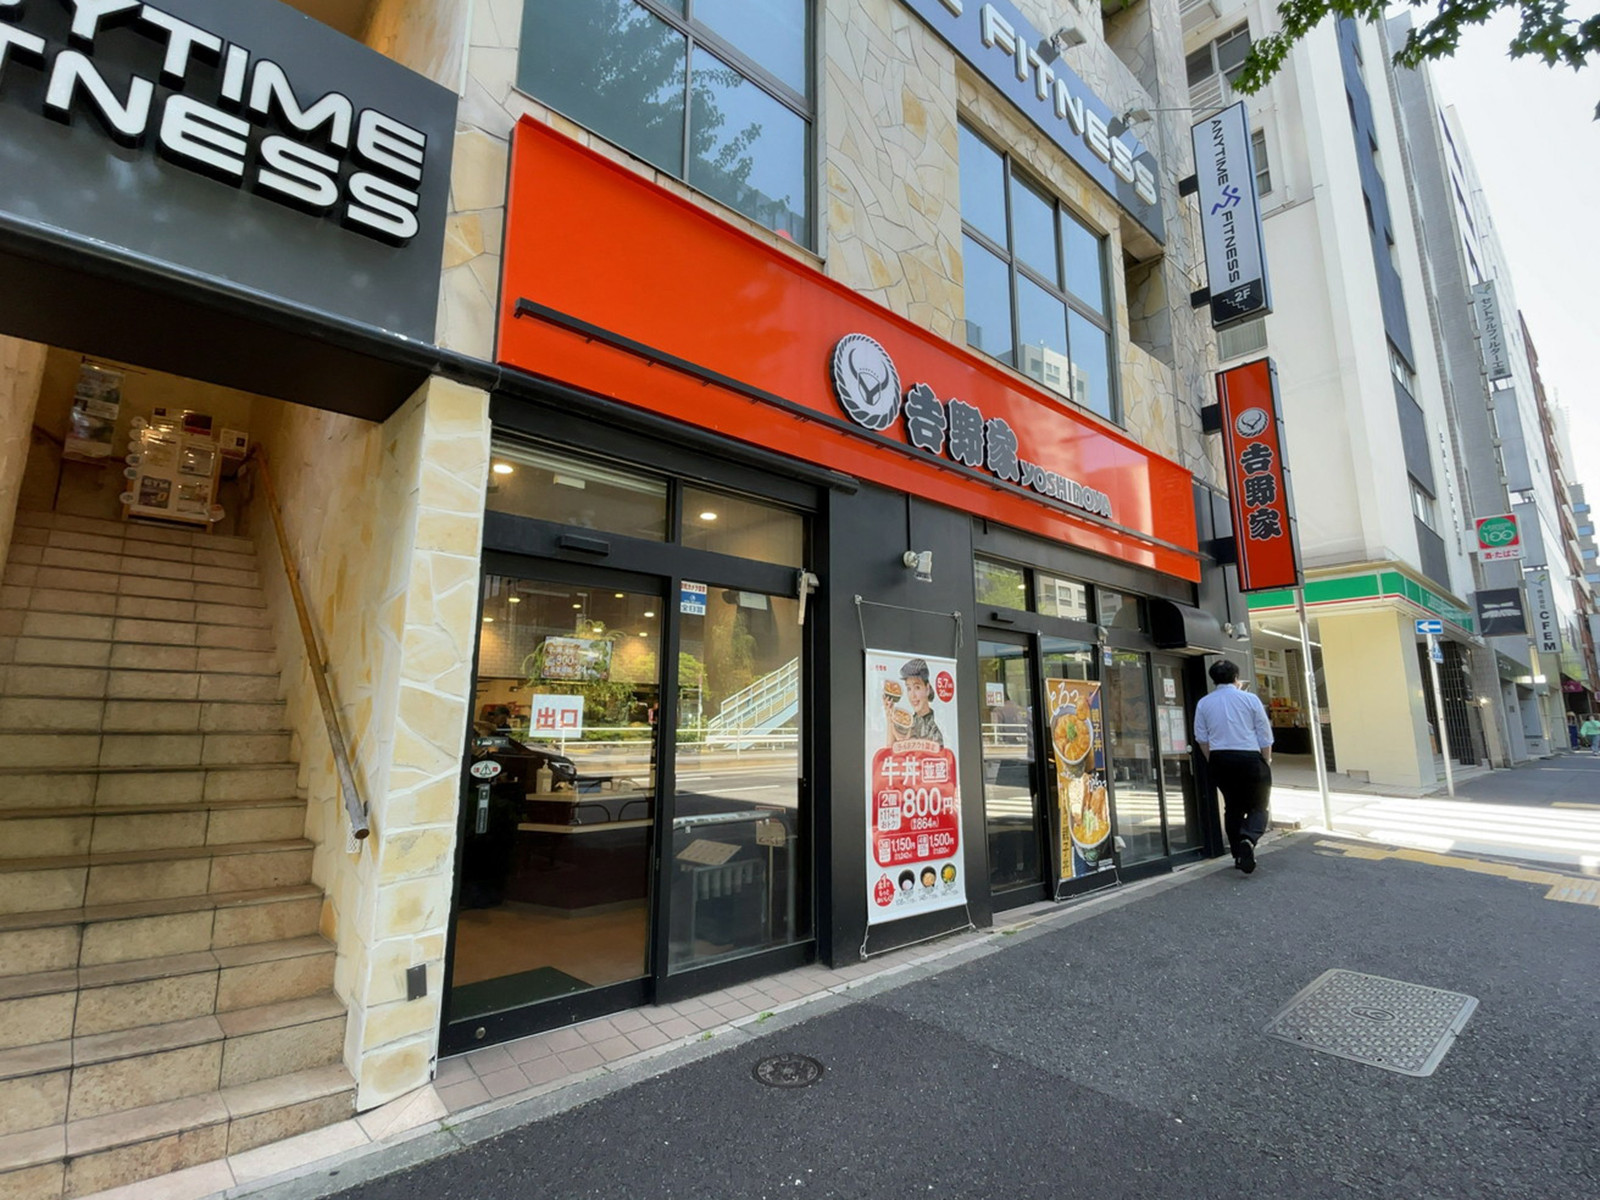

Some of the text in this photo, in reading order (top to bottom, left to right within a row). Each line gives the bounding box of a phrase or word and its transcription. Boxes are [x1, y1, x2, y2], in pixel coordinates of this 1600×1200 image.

[0, 0, 428, 184] YTIME
[980, 2, 1158, 207] FITNESS
[1211, 119, 1240, 284] ANYTIME FITNESS
[1233, 287, 1251, 303] 2F
[904, 382, 1020, 483] 吉野家
[1020, 459, 1113, 519] YOSHINOYA
[1240, 441, 1282, 542] 吉野家
[1483, 530, 1515, 544] 100
[1540, 611, 1557, 651] CFEM
[536, 706, 579, 730] 出口
[881, 756, 947, 786] 牛丼 並盛
[903, 787, 954, 818] 800円
